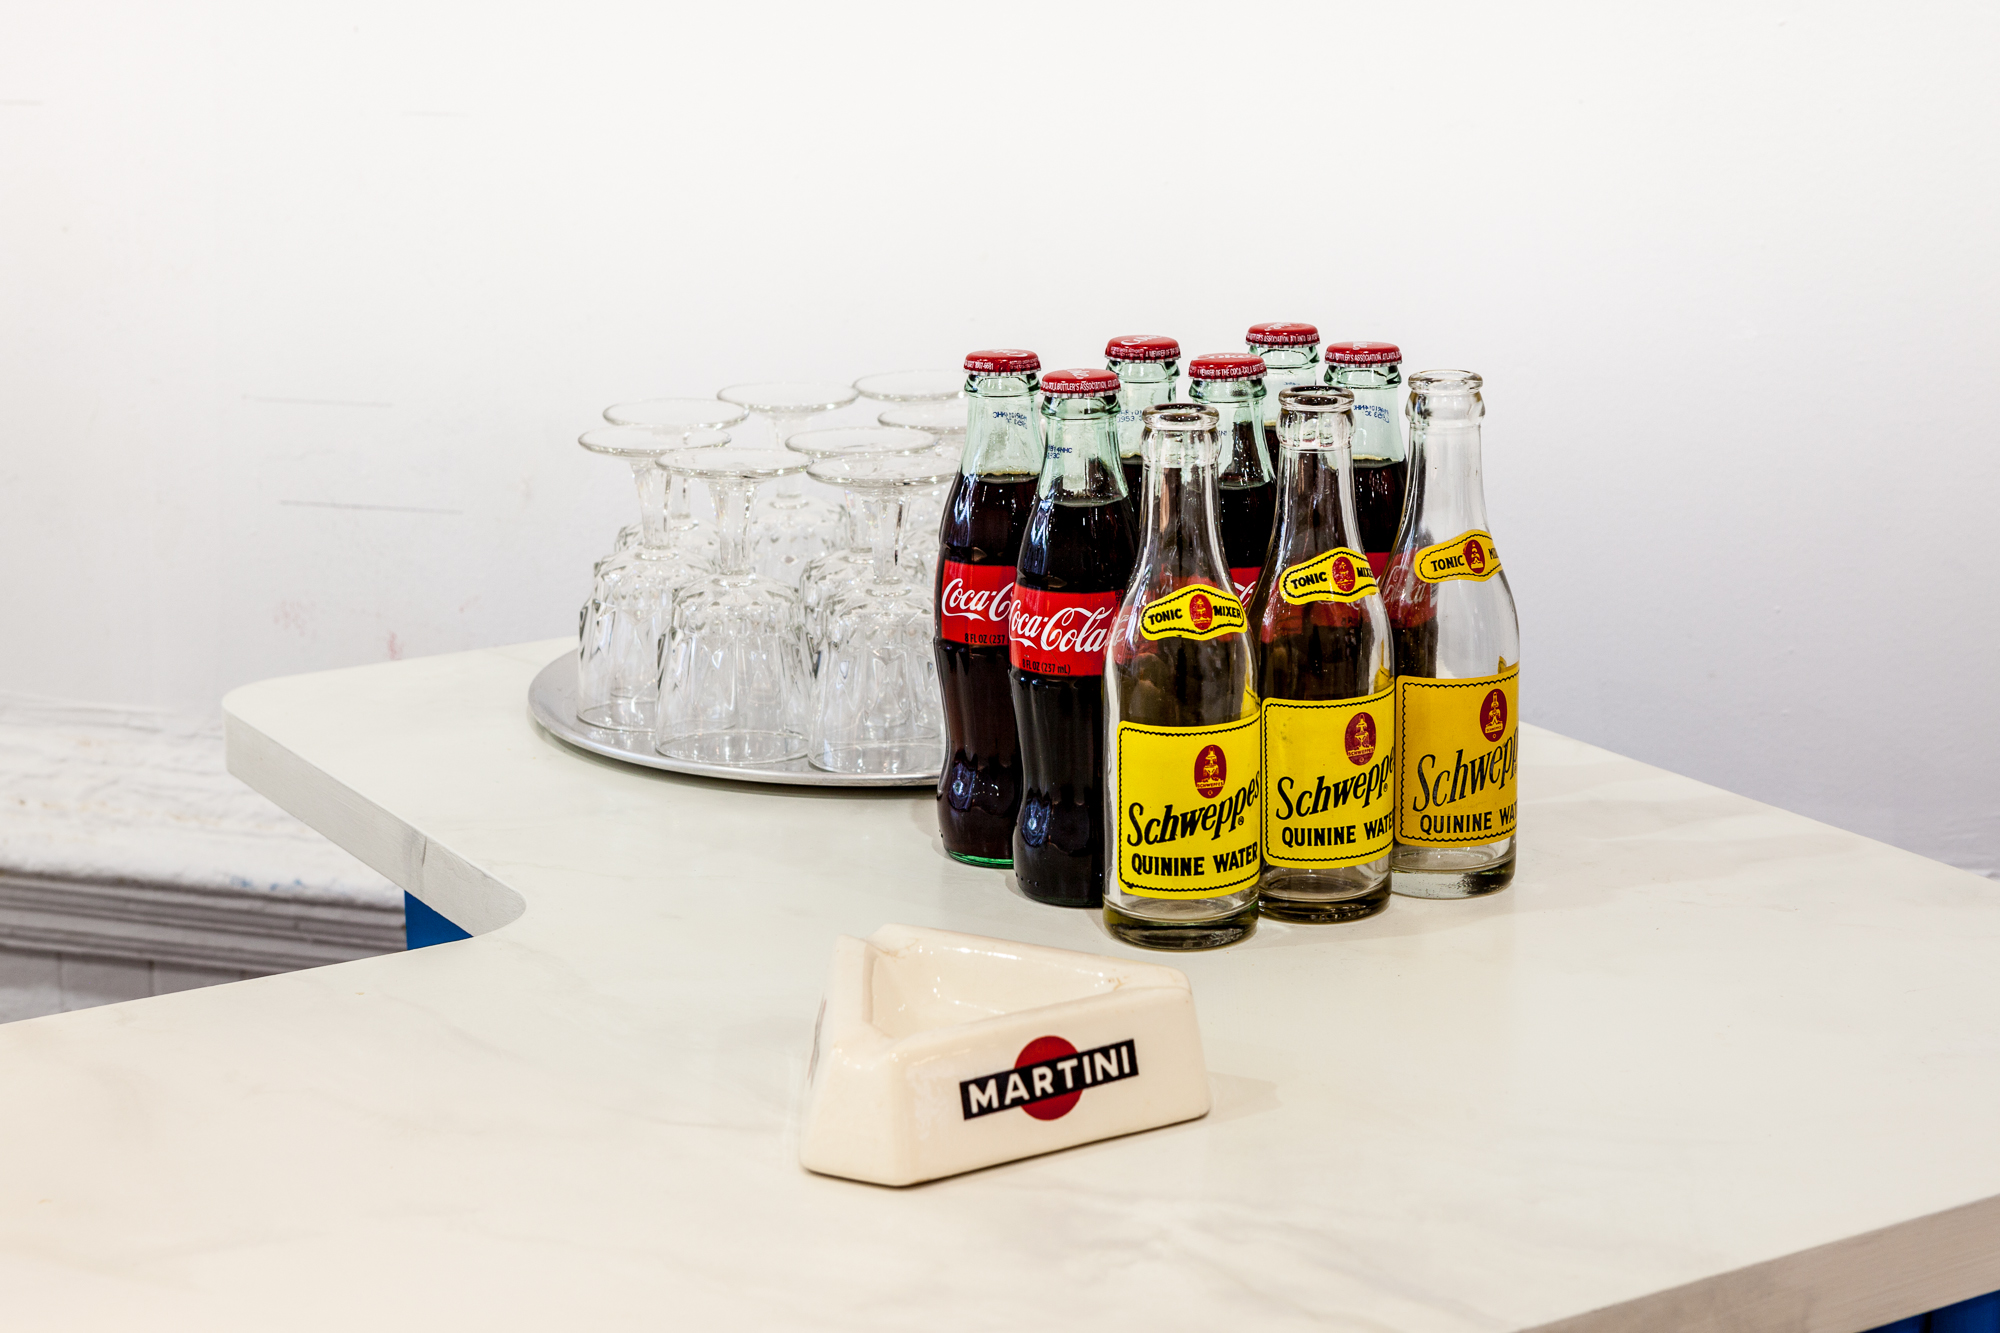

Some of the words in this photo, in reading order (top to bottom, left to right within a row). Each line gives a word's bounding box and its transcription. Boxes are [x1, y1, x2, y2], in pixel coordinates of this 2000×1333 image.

[1290, 572, 1327, 589] TONIC
[1356, 566, 1374, 578] MIXE
[1431, 555, 1465, 572] TONIC
[941, 578, 1014, 622] Coca-C
[1147, 608, 1183, 626] TONIC
[1213, 605, 1242, 620] MIXER
[969, 632, 977, 643] FL
[978, 634, 987, 644] OZ
[1009, 599, 1114, 653] Coca-Cola
[1026, 660, 1032, 670] FL
[1032, 662, 1040, 671] OZ
[1041, 663, 1056, 673] (237
[1057, 665, 1071, 674] mL)
[1275, 745, 1395, 821] Schweppe
[1412, 726, 1518, 812] Schwepp
[1126, 770, 1260, 847] Schweppes
[1420, 810, 1493, 835] QUININE
[1281, 826, 1356, 848] QUININE
[1363, 811, 1394, 841] WATE
[1131, 852, 1205, 877] QUININE
[1213, 841, 1258, 873] WATER
[967, 1044, 1132, 1115] MARTINI
